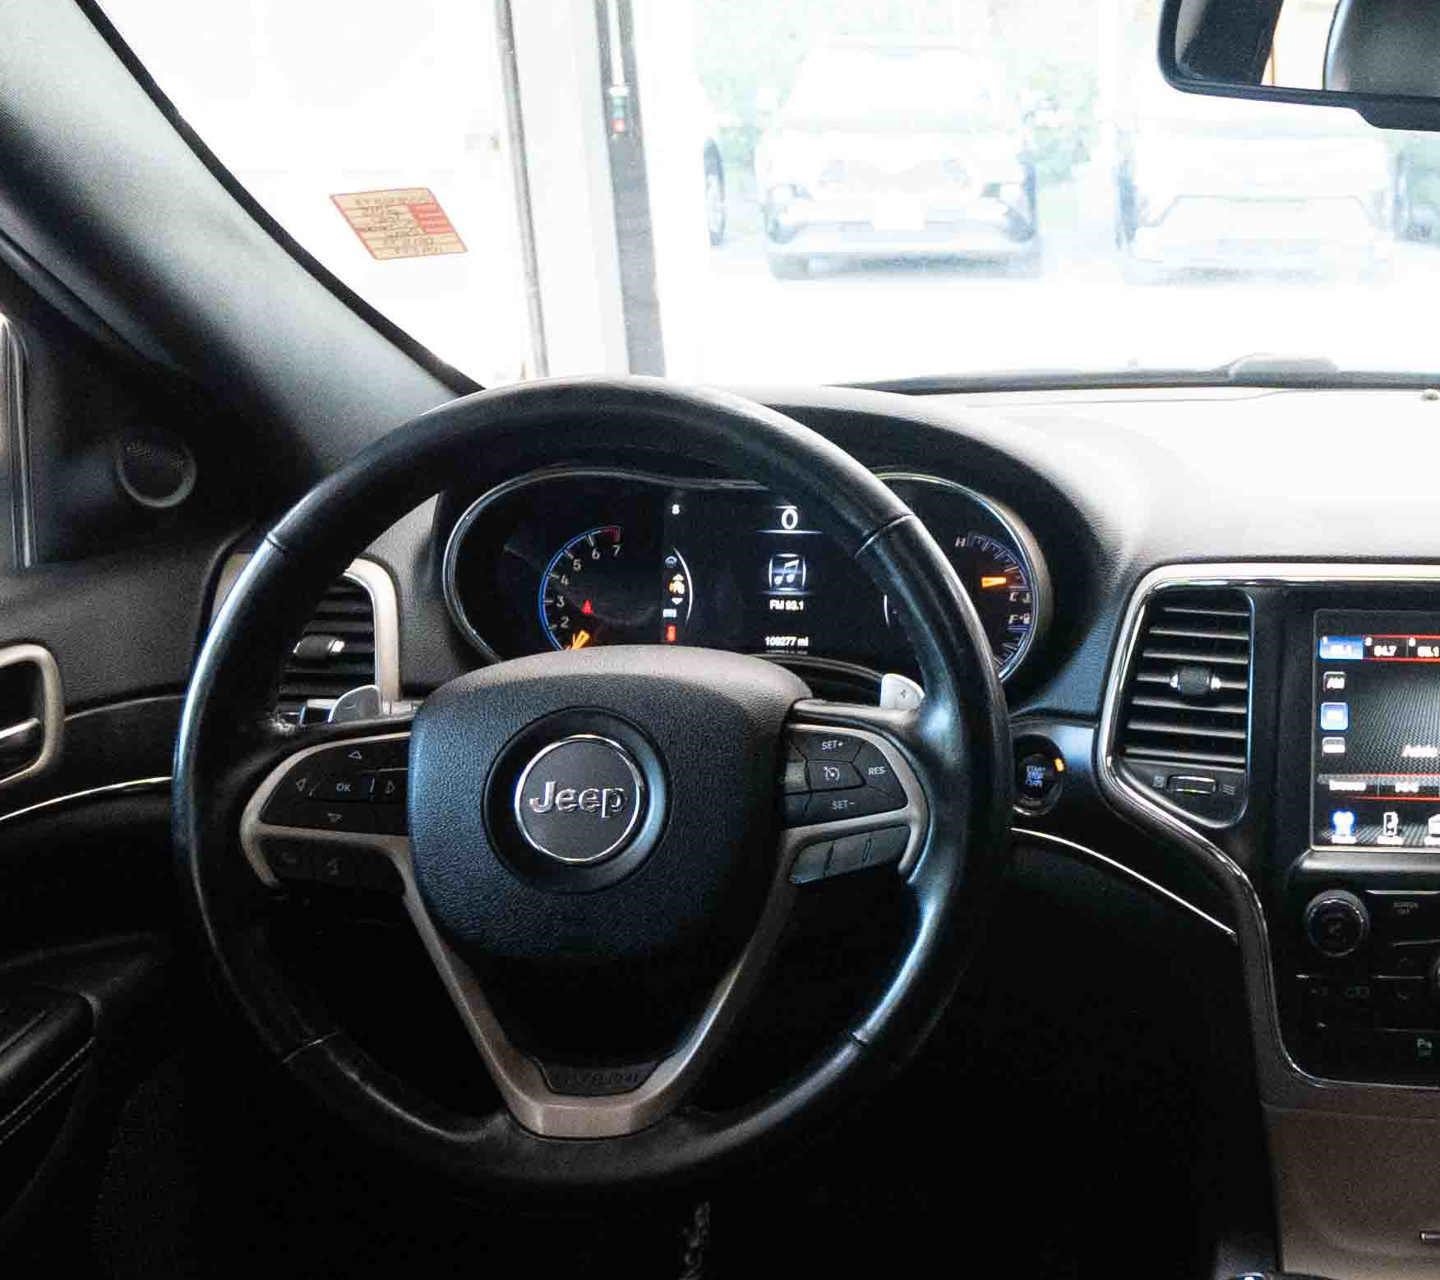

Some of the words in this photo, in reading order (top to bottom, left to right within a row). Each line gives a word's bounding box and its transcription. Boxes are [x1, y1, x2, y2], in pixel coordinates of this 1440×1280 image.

[781, 509, 798, 529] 0
[592, 548, 600, 560] 6
[613, 545, 620, 556] 7
[573, 560, 582, 571] 5
[561, 574, 569, 585] 4
[556, 596, 565, 607] 3
[561, 616, 570, 628] 2
[336, 783, 351, 792] OK
[530, 781, 625, 818] Jeep
